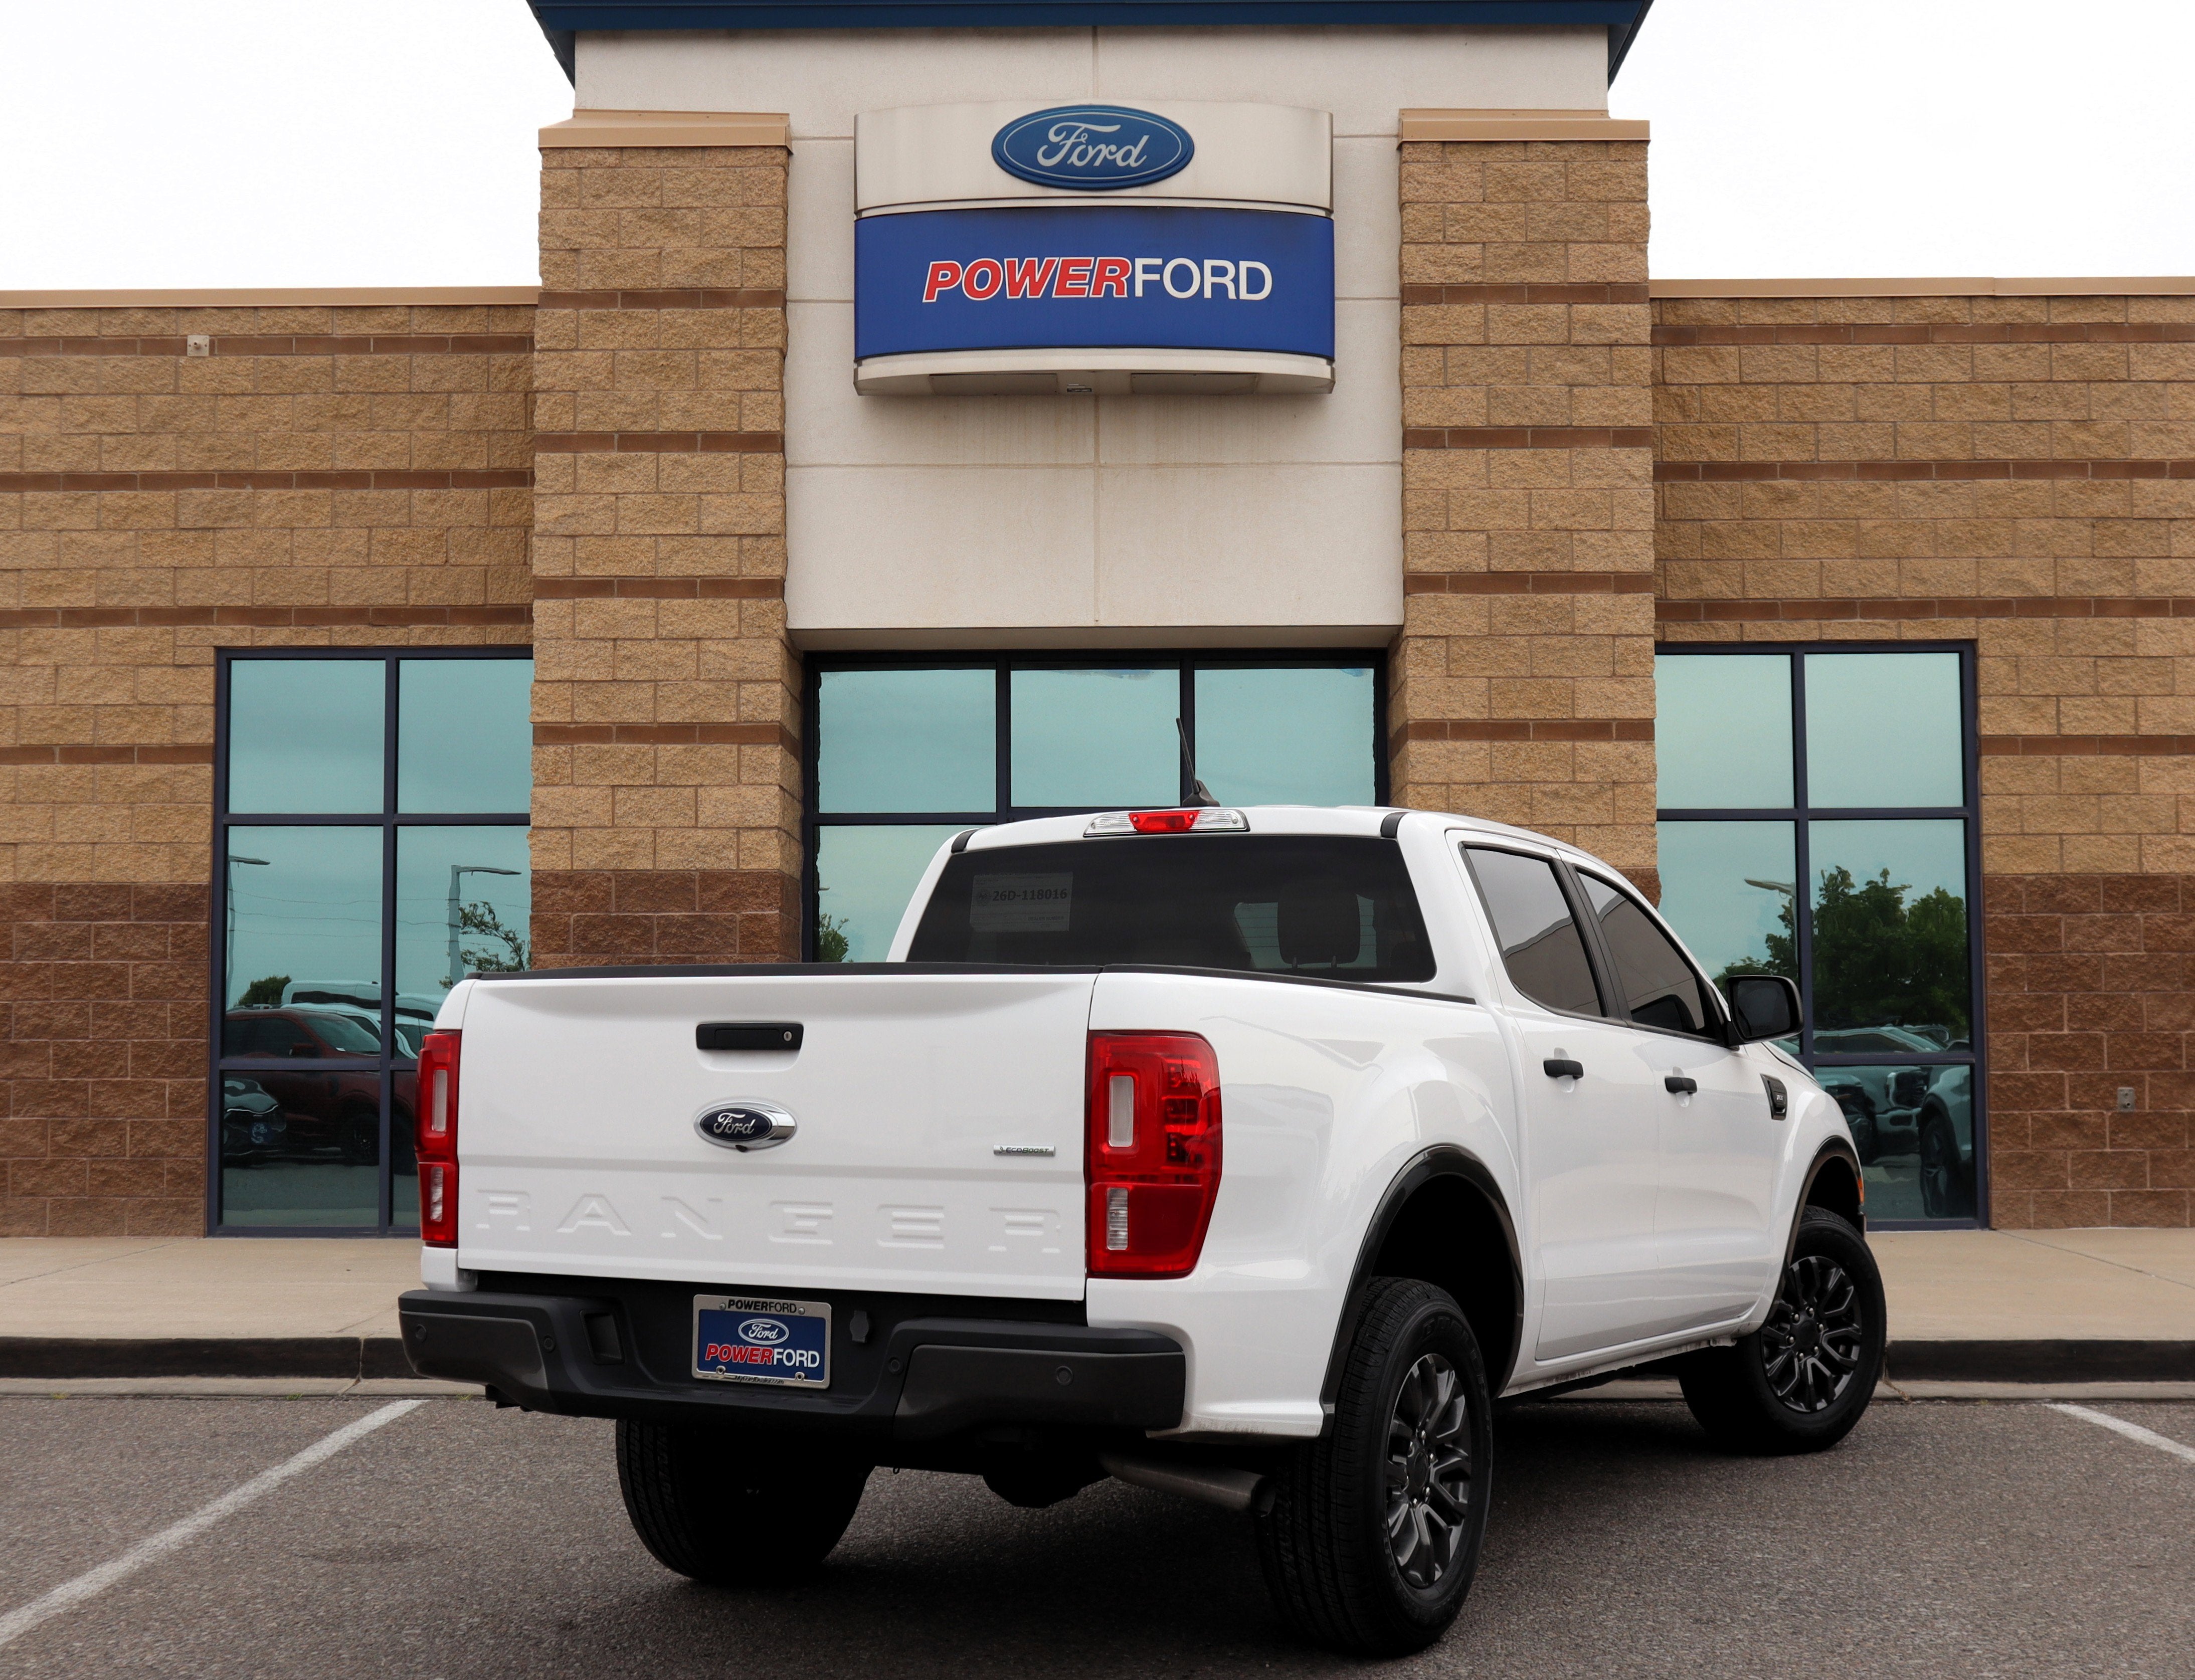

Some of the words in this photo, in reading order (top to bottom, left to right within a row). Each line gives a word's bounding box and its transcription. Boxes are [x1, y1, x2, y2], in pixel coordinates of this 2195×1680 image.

[1037, 122, 1149, 166] Ford
[923, 257, 1272, 302] POWERFORD
[992, 888, 1067, 901] 26D-118016
[713, 1112, 756, 1134] Ford
[476, 1189, 1060, 1251] RANGER
[728, 1299, 796, 1313] POWERFORD
[748, 1323, 779, 1340] Ford
[706, 1344, 820, 1367] POWERFORD
